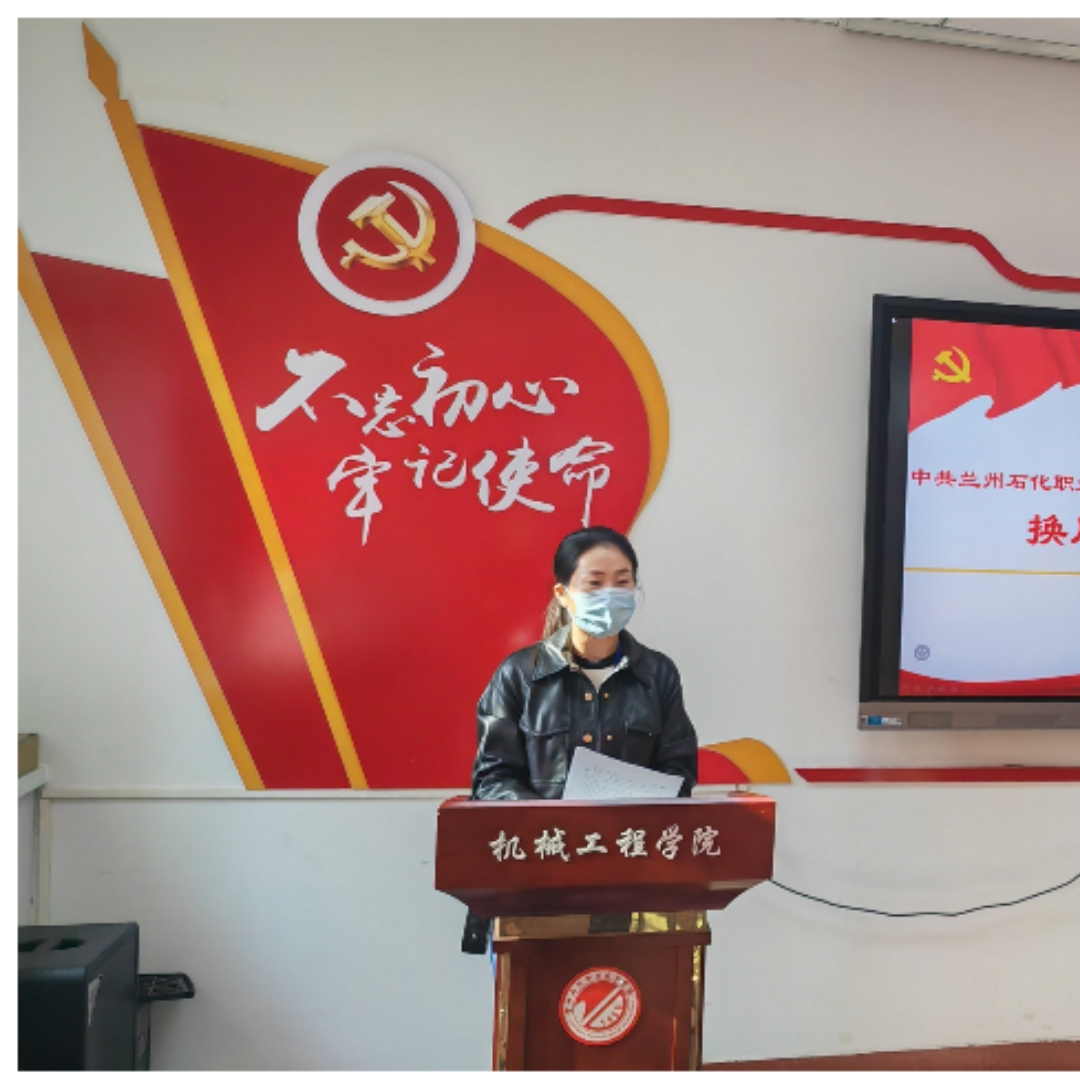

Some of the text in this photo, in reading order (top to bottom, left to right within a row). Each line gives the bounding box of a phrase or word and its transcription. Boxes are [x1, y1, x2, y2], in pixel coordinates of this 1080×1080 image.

[255, 343, 579, 438] 不忘初心
[327, 436, 615, 546] 牢记使命
[488, 825, 722, 865] 机械工程学院
